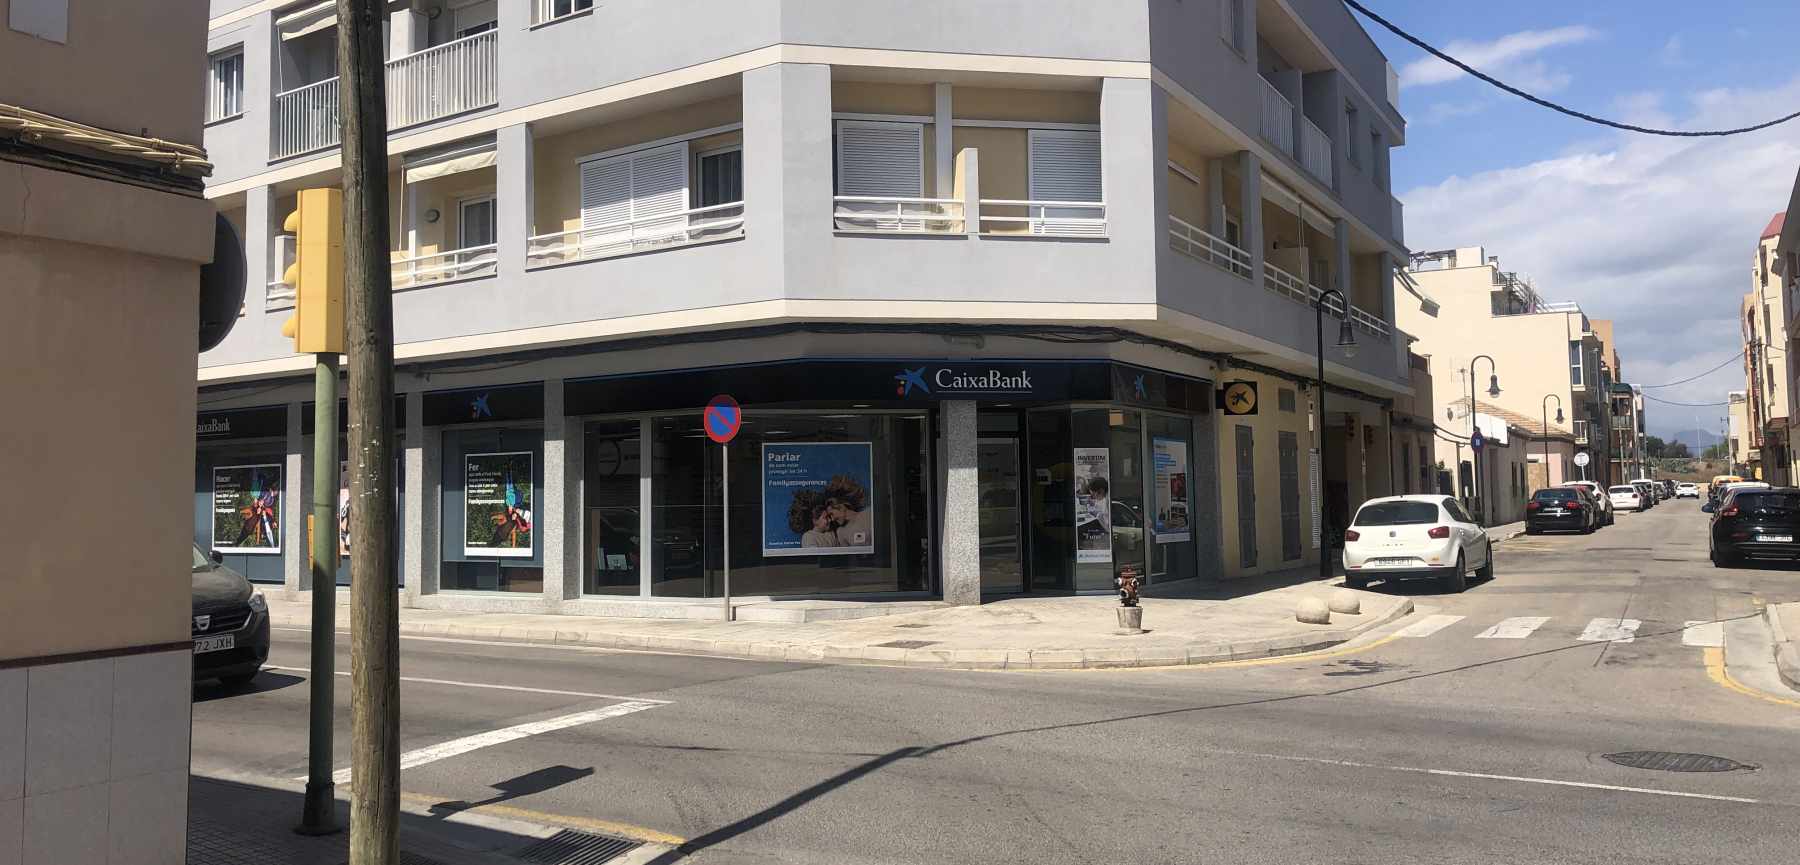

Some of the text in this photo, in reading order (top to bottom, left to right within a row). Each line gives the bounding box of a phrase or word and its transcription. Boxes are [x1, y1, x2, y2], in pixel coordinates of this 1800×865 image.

[935, 368, 1032, 388] CaixaBank
[768, 452, 800, 462] Parlar
[214, 636, 233, 649] JXH
